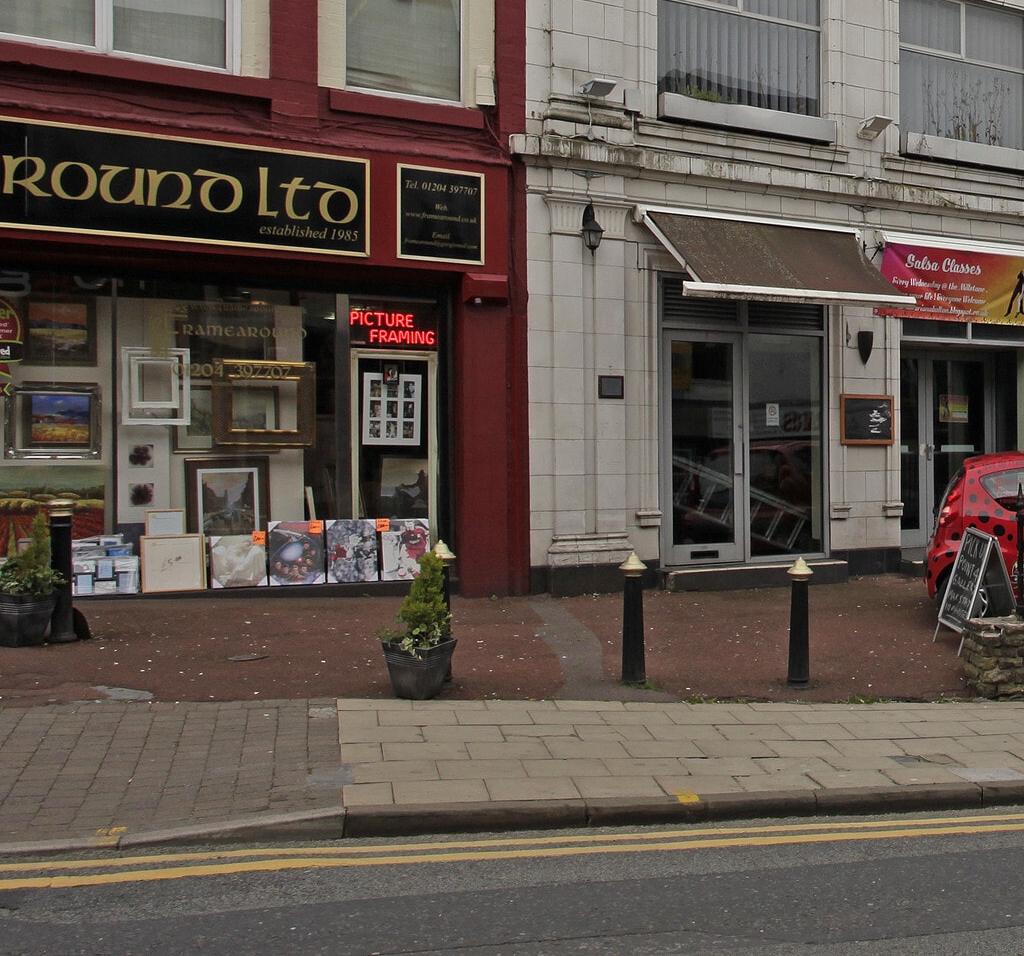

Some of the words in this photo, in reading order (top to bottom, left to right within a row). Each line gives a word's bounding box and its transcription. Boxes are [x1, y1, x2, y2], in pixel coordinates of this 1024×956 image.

[405, 179, 419, 190] Tel.
[421, 182, 447, 193] 01204
[448, 184, 478, 197] 397707
[259, 224, 328, 239] established
[331, 228, 359, 242] 1985
[905, 253, 940, 272] Salsa
[941, 257, 982, 276] Classes
[891, 276, 909, 288] Every
[910, 278, 941, 290] Wednesday
[948, 282, 958, 290] the
[936, 293, 962, 304] Everyone
[349, 310, 415, 329] PICTURE
[368, 329, 435, 345] FRAMING
[234, 365, 291, 379] 397707
